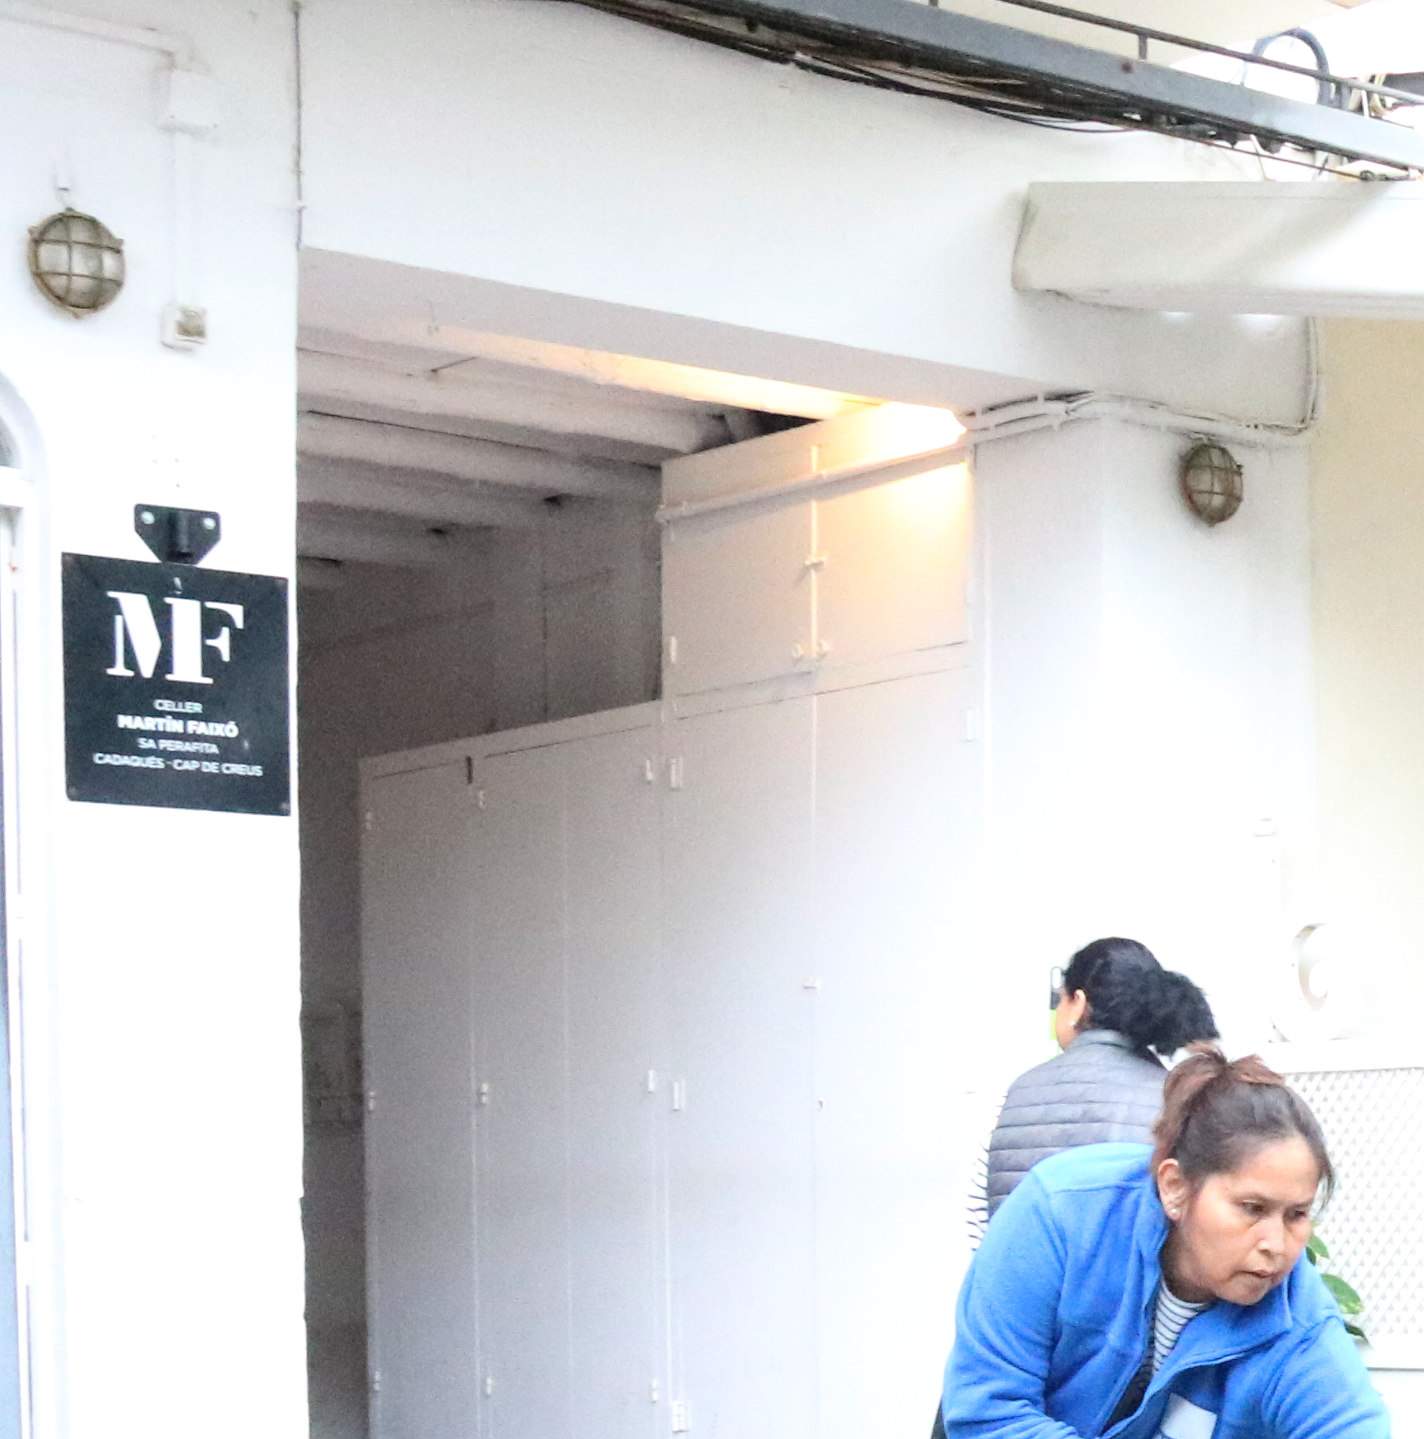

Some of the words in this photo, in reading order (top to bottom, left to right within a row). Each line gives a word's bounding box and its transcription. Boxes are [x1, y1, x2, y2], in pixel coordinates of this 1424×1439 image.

[106, 591, 244, 684] MF
[153, 699, 203, 714] CELLER
[117, 714, 184, 734] MARTÍN
[187, 721, 239, 738] FAIXÓ
[137, 737, 158, 750] SA
[93, 752, 165, 769] CADAQUÉS
[172, 759, 200, 771] CAP
[201, 761, 221, 773] DE
[221, 763, 264, 777] CREUS
